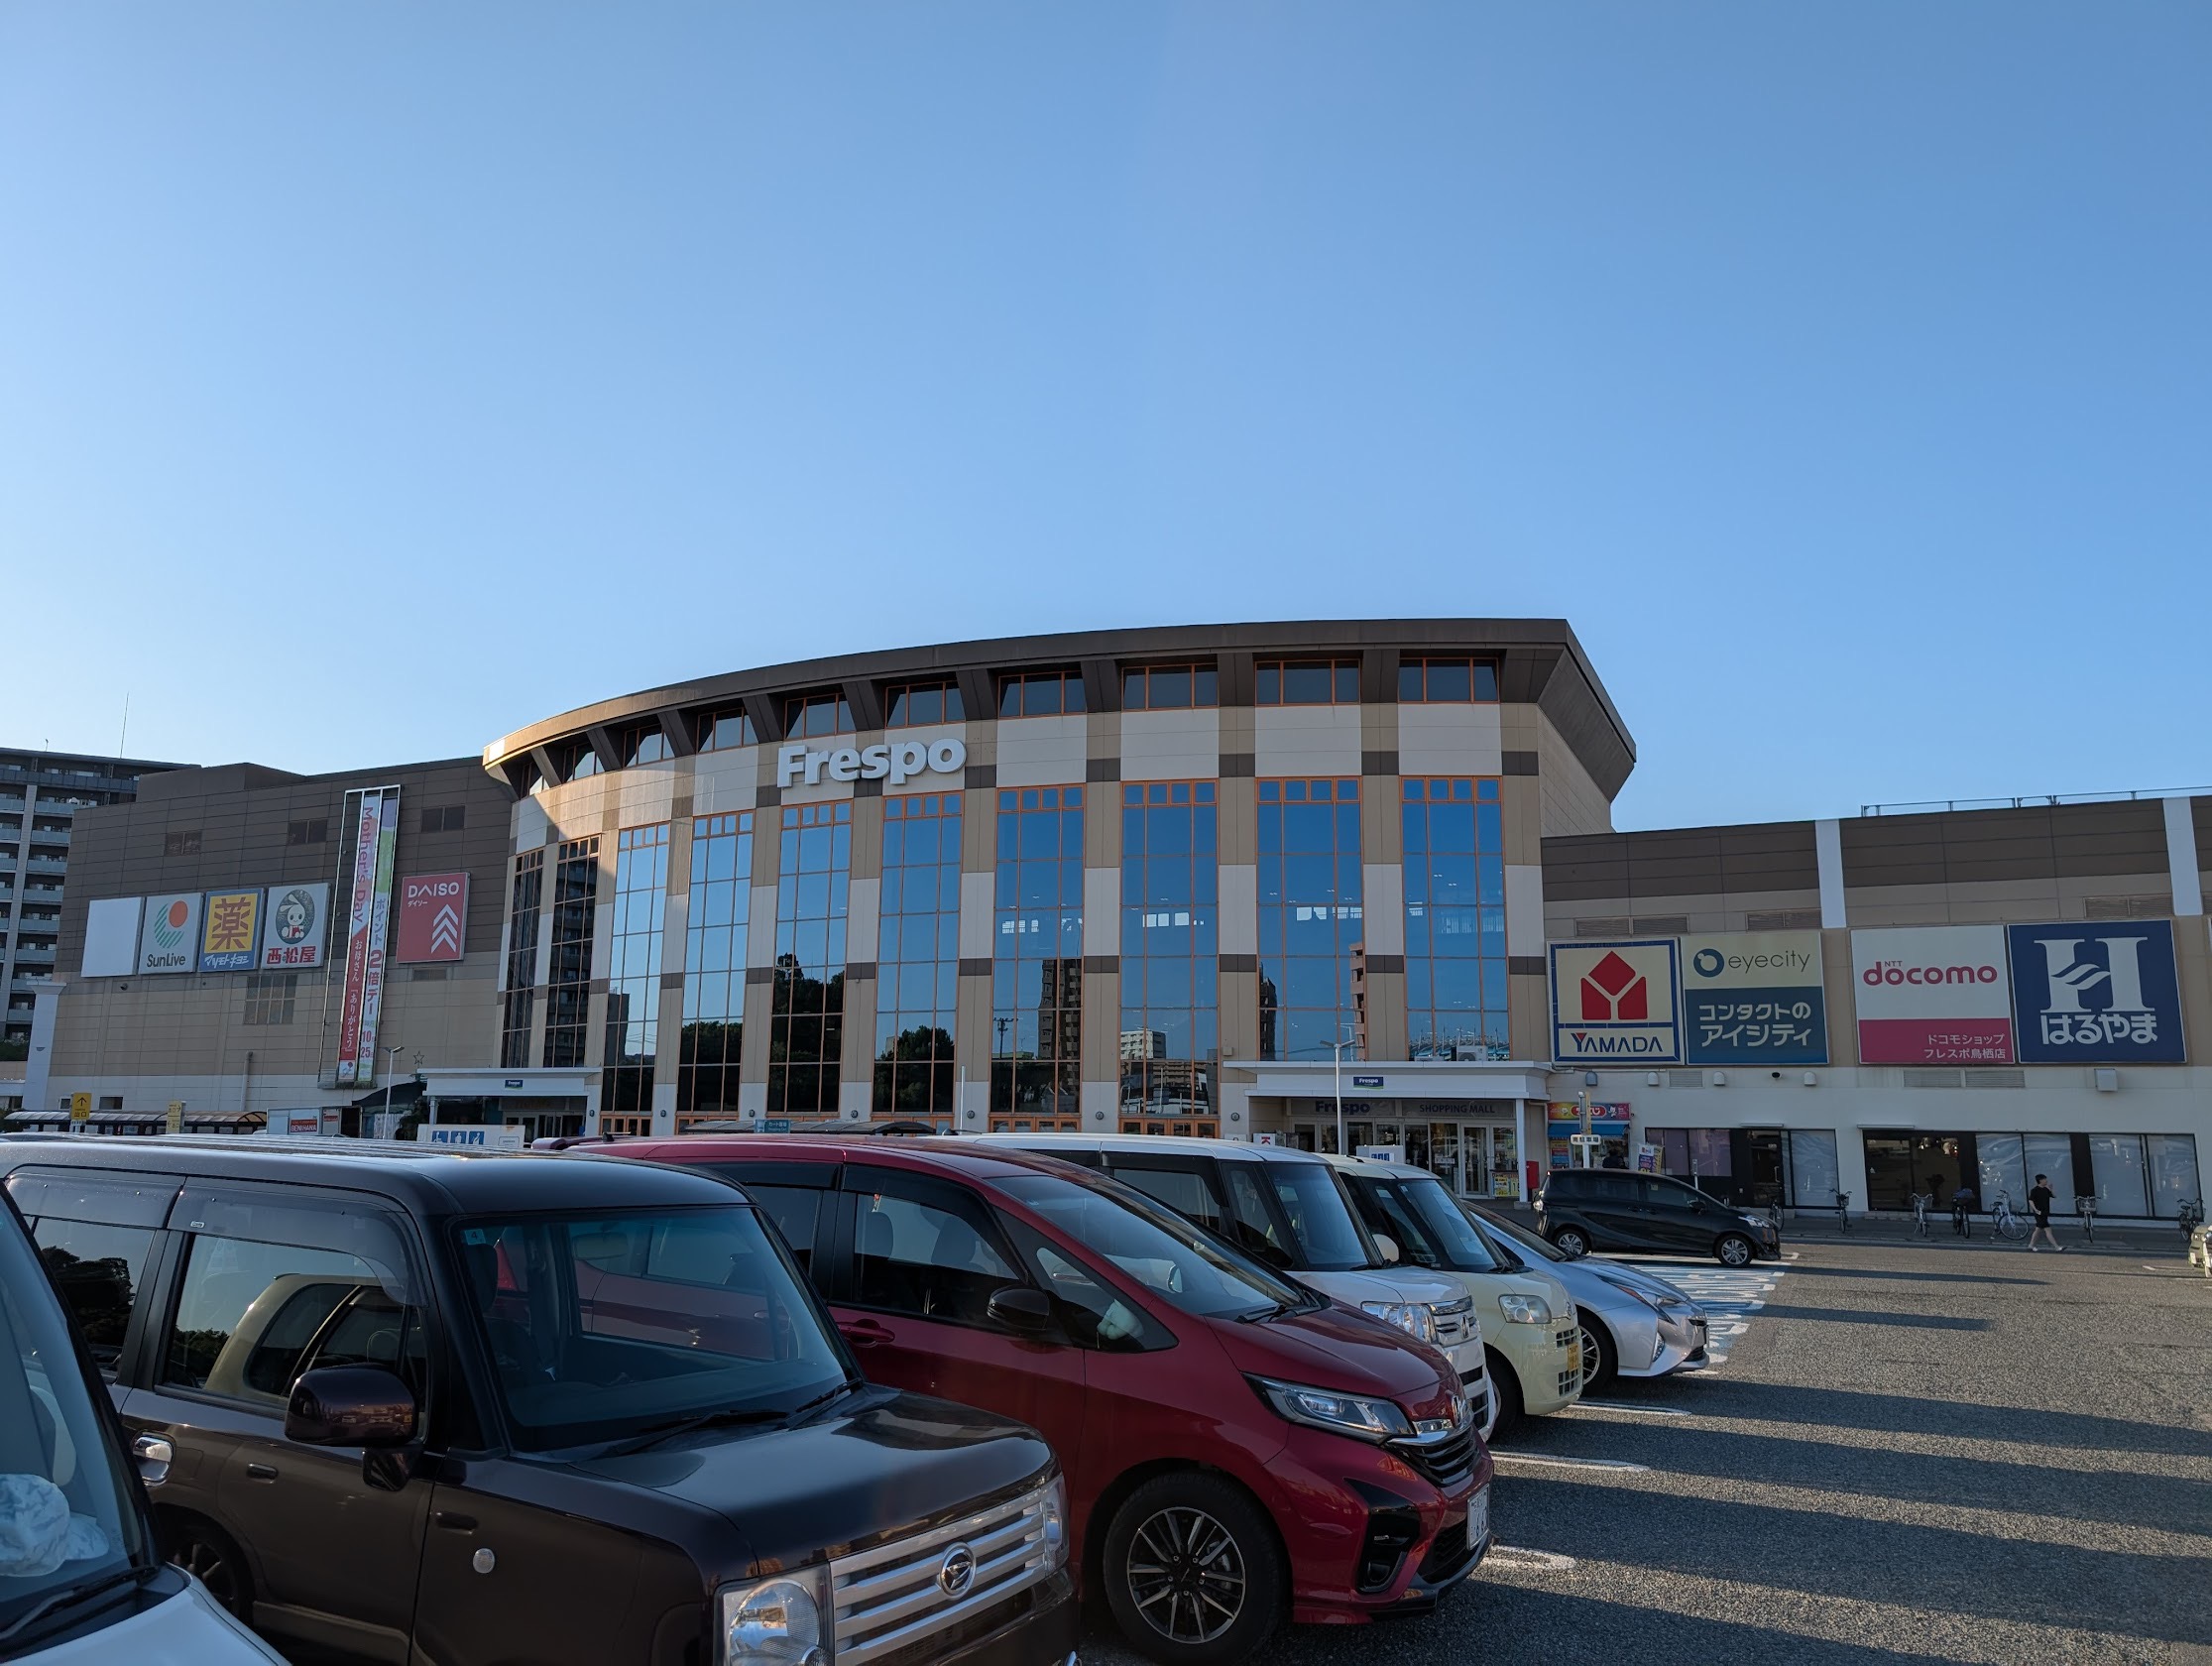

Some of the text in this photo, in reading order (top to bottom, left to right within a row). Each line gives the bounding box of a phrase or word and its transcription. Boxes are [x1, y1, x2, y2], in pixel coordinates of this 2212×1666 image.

[776, 738, 968, 787] Frespo
[353, 806, 374, 922] Mother's Day
[407, 882, 460, 898] DAISO
[210, 896, 252, 950] 薬
[146, 952, 186, 968] SunLive
[204, 953, 250, 969] マツモトキヨシ
[266, 945, 316, 965] 西松屋
[351, 940, 363, 982] お母さん
[1728, 950, 1810, 974] eyecity
[1863, 961, 1998, 987] docomo
[1698, 1002, 1811, 1021] コンタクトの
[1699, 1023, 1812, 1047] アイシティ
[1926, 1033, 2006, 1045] ドコモショップ
[2039, 1012, 2158, 1045] はるやま
[1571, 1032, 1664, 1053] YAMADA
[1922, 1047, 2007, 1059] フレスポ鳥栖店
[1419, 1103, 1495, 1114] SHOPPING MALL
